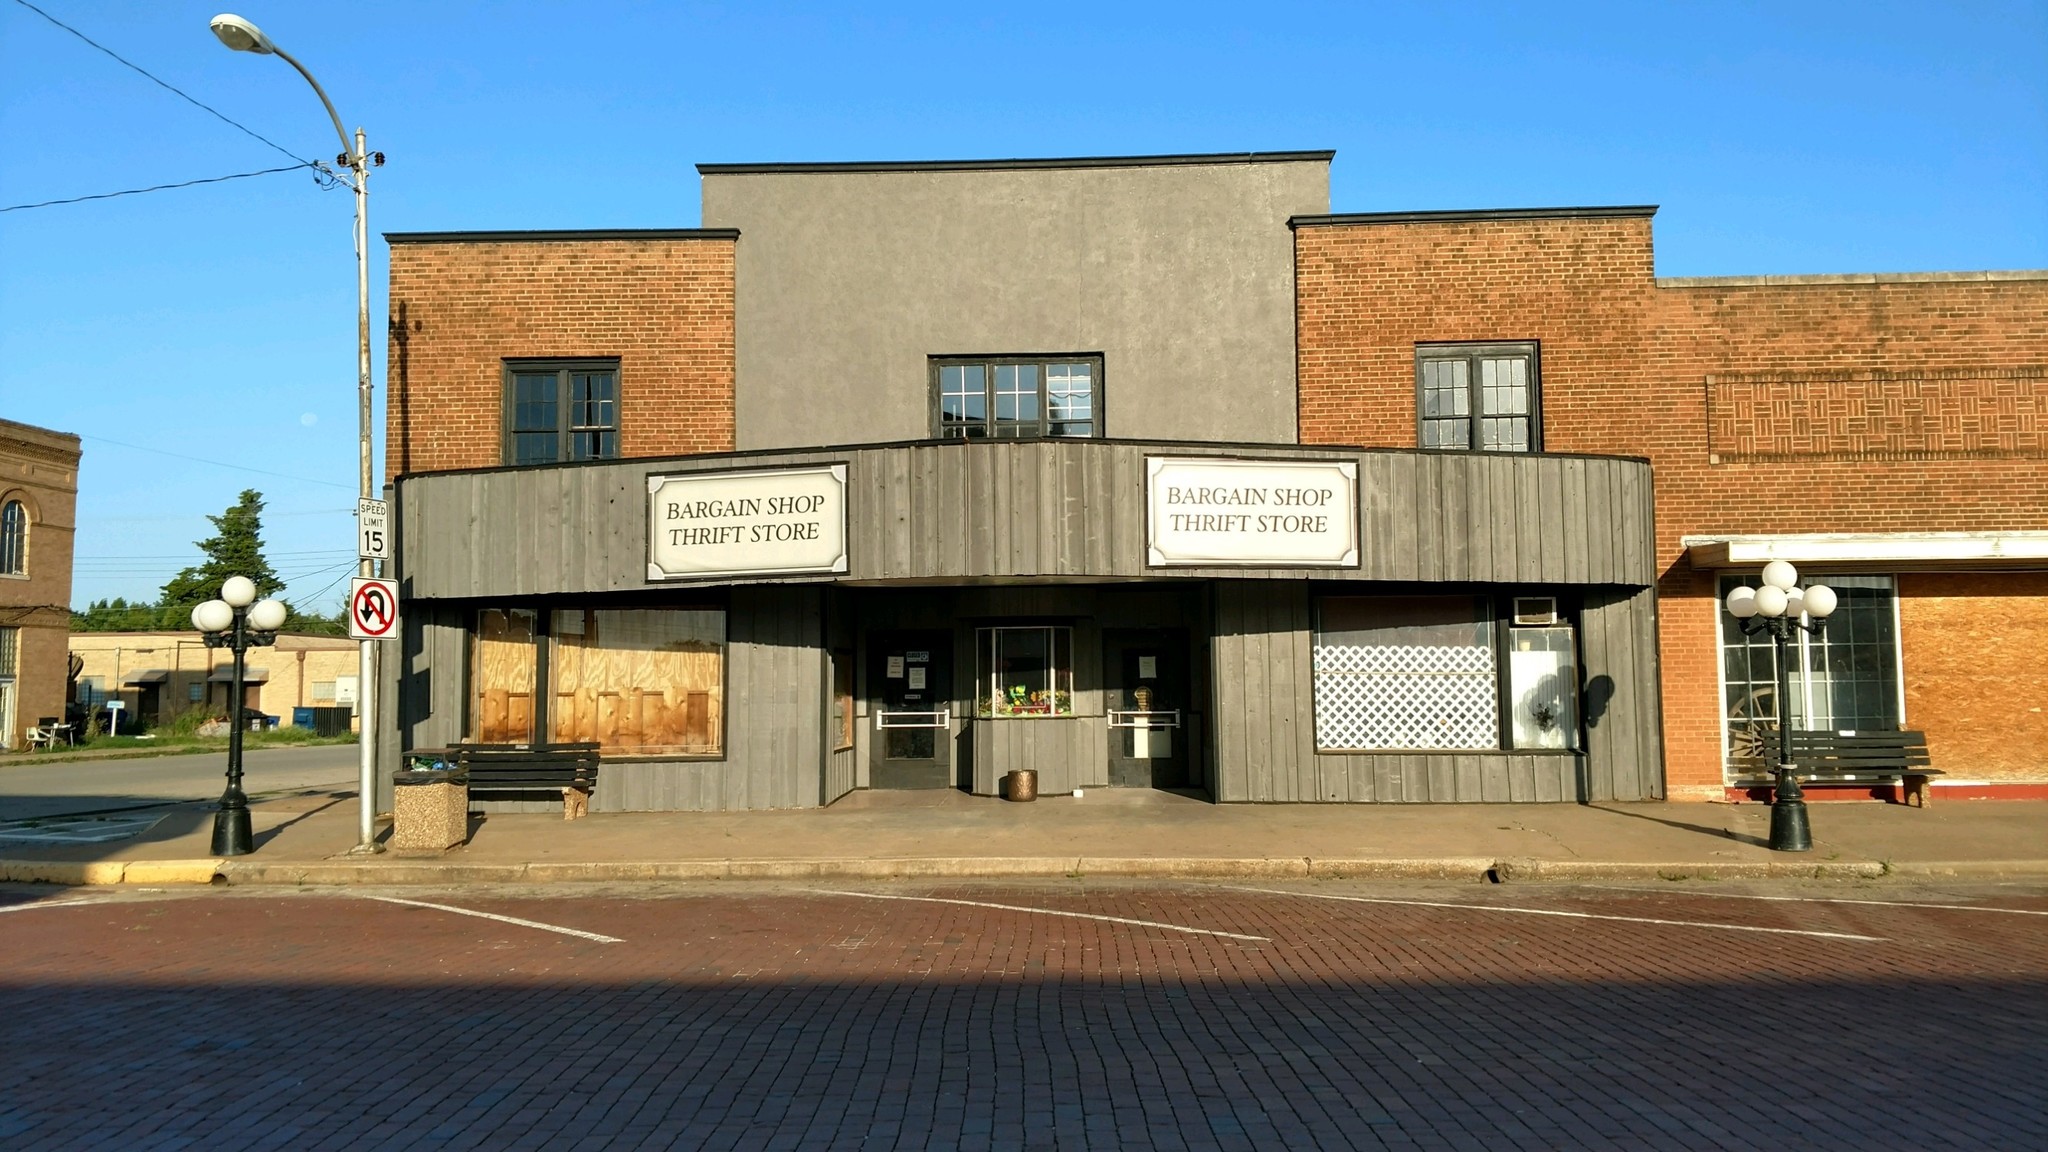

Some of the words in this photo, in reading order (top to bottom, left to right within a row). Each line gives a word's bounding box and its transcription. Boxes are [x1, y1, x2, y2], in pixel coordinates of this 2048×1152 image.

[1167, 486, 1268, 505] BARGAIN
[1273, 488, 1333, 507] SHOP
[361, 504, 386, 516] SPEED
[666, 498, 761, 520] BARGAIN
[767, 495, 825, 515] SHOP
[363, 517, 383, 528] LIMIT
[1169, 514, 1252, 532] THRIFT
[1257, 515, 1328, 533] STORE
[364, 530, 383, 552] 15
[668, 525, 745, 546] THRIFT
[750, 522, 820, 543] STORE
